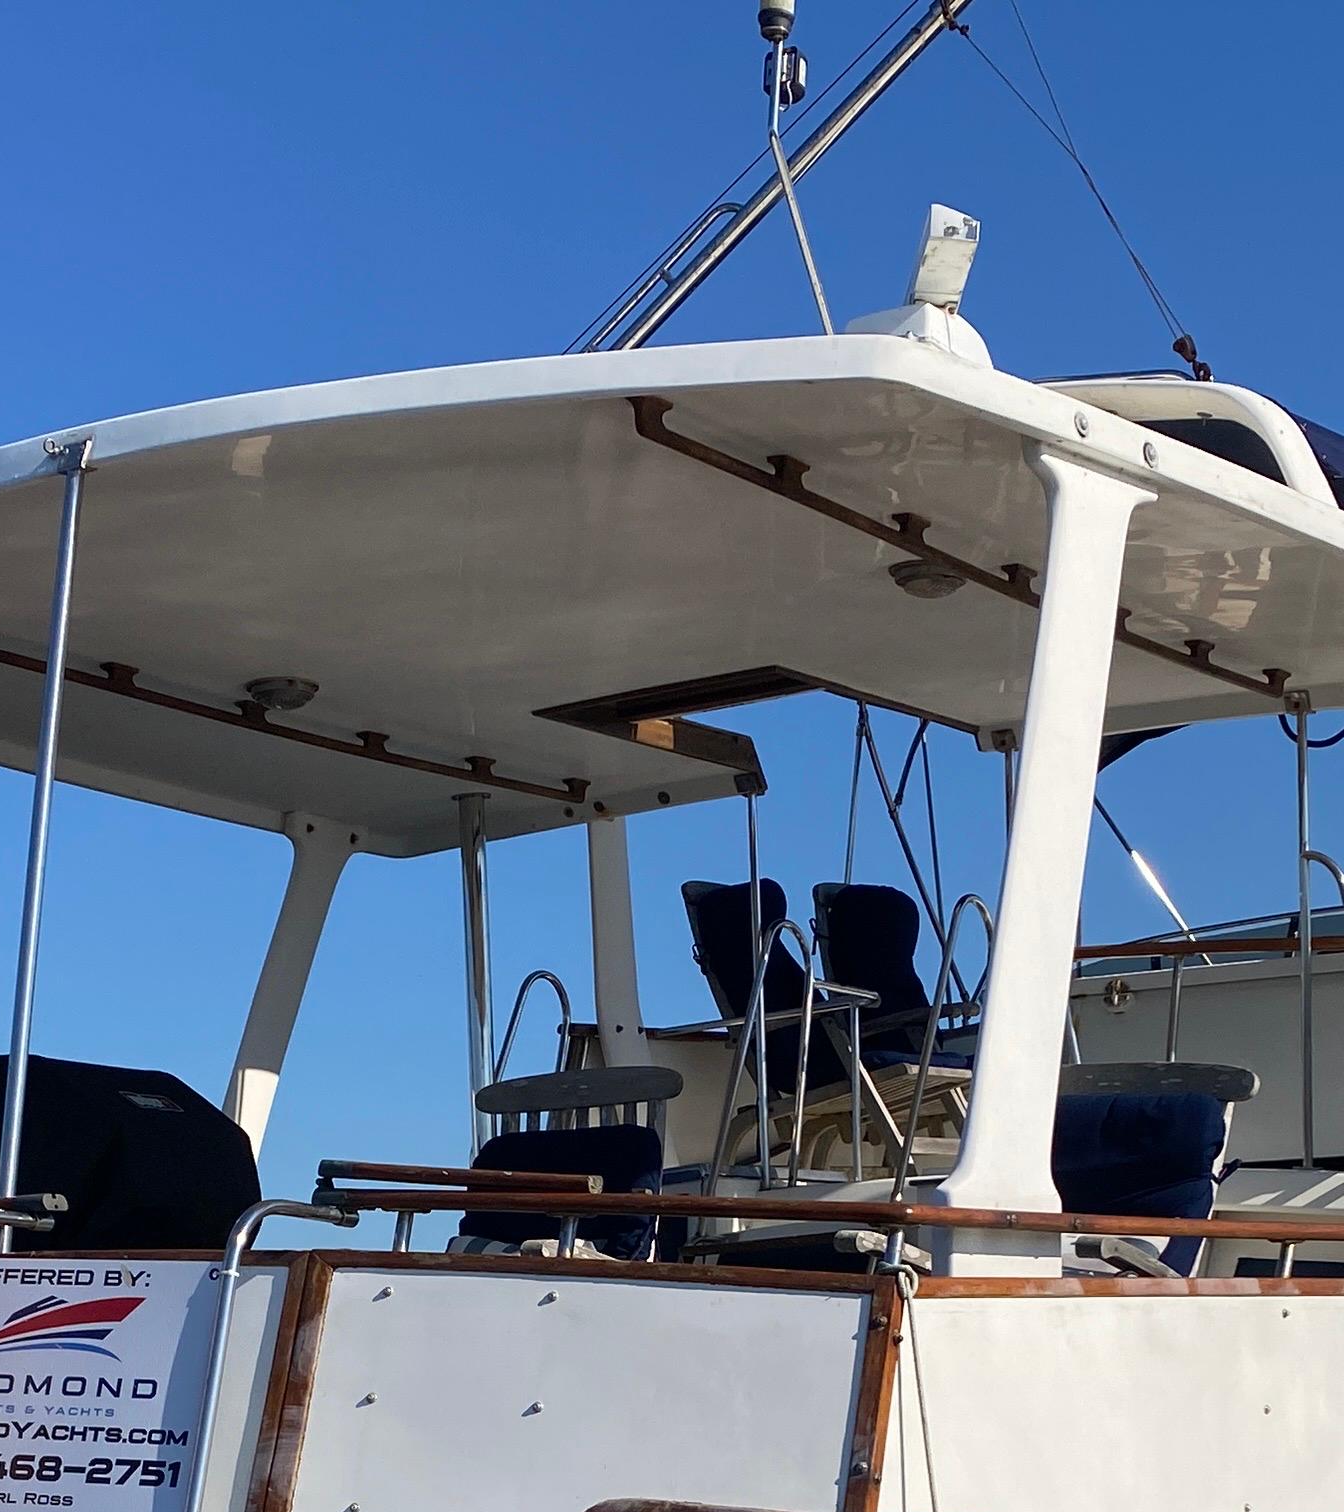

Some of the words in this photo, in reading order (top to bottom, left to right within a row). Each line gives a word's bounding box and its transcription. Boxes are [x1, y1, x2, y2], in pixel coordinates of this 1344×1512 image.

[103, 1269, 151, 1287] BY:
[25, 1405, 36, 1415] &
[44, 1406, 116, 1418] YACHTS
[23, 1491, 74, 1507] ROSS
